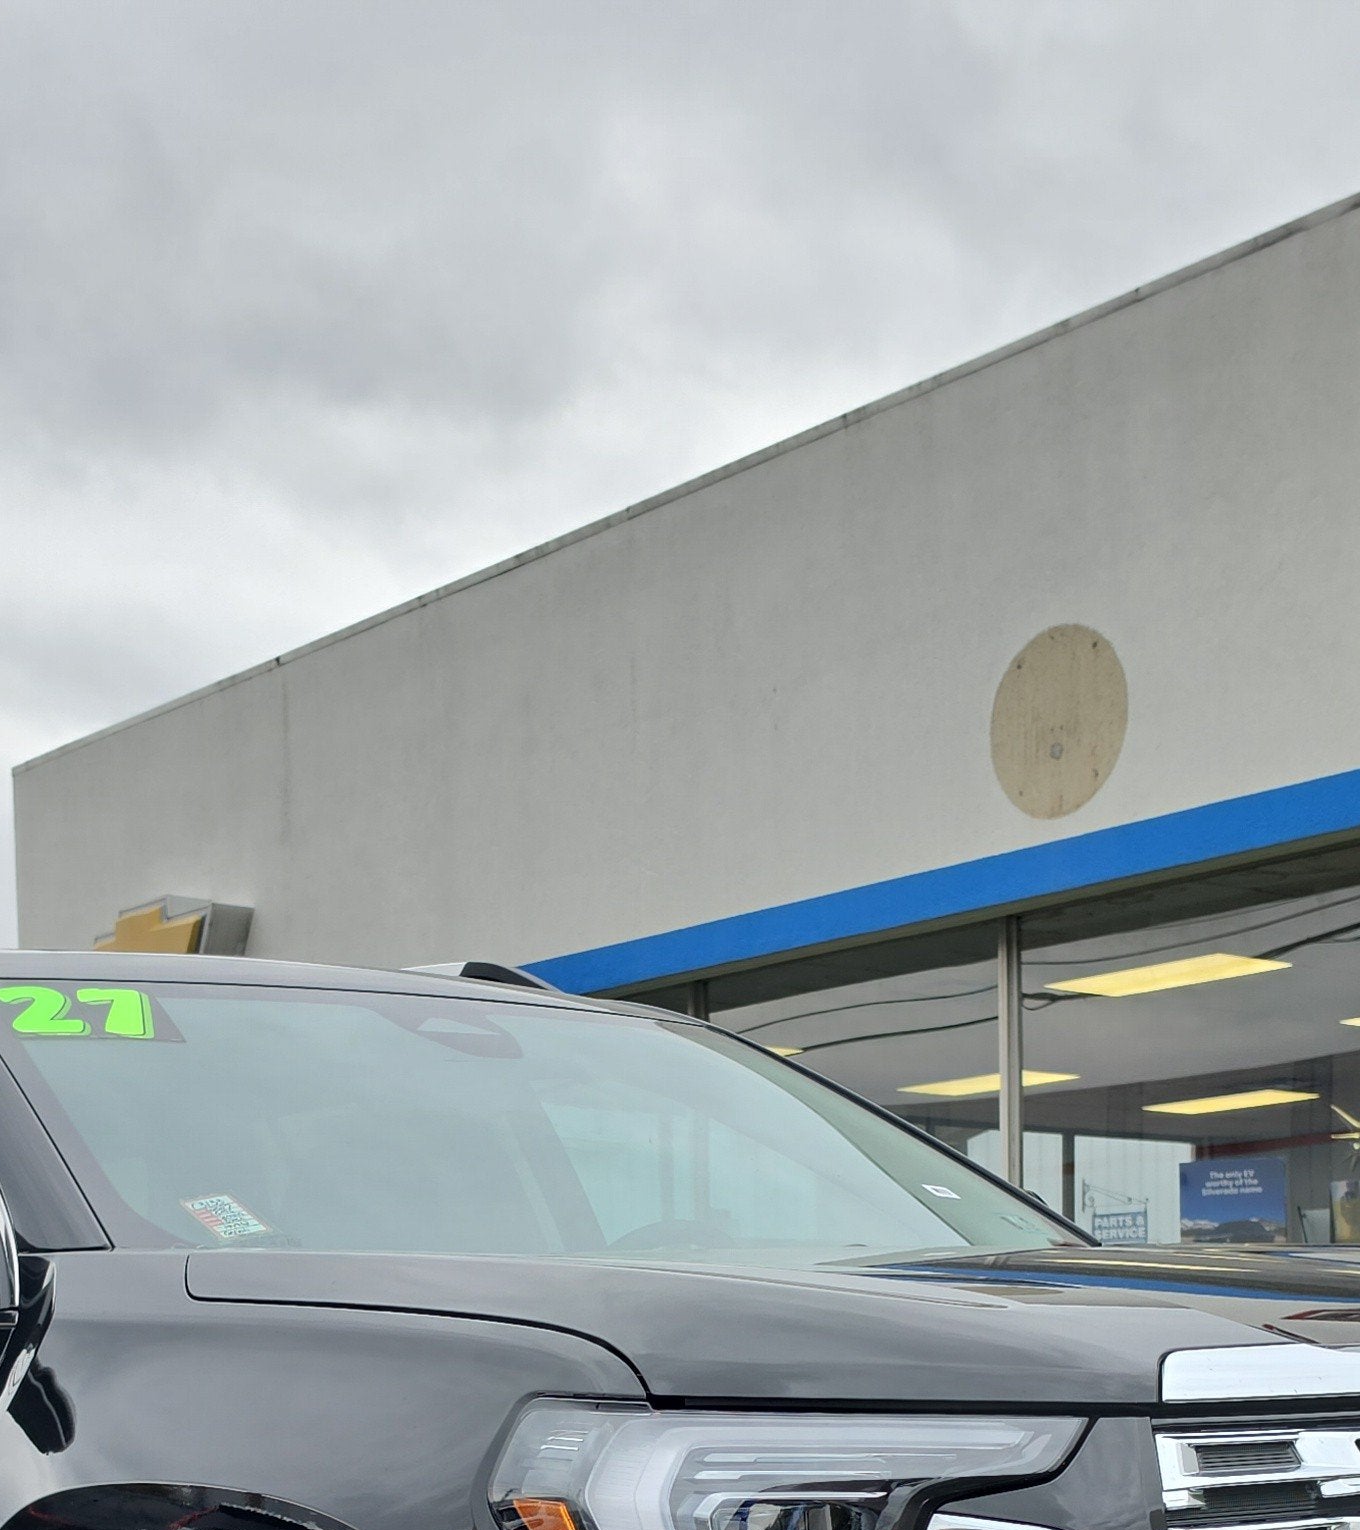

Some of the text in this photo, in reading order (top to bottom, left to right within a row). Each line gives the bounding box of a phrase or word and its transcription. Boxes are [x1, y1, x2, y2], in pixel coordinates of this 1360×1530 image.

[1209, 1170, 1224, 1179] The
[1094, 1216, 1133, 1228] PARTS
[1093, 1227, 1147, 1239] SERVICE
